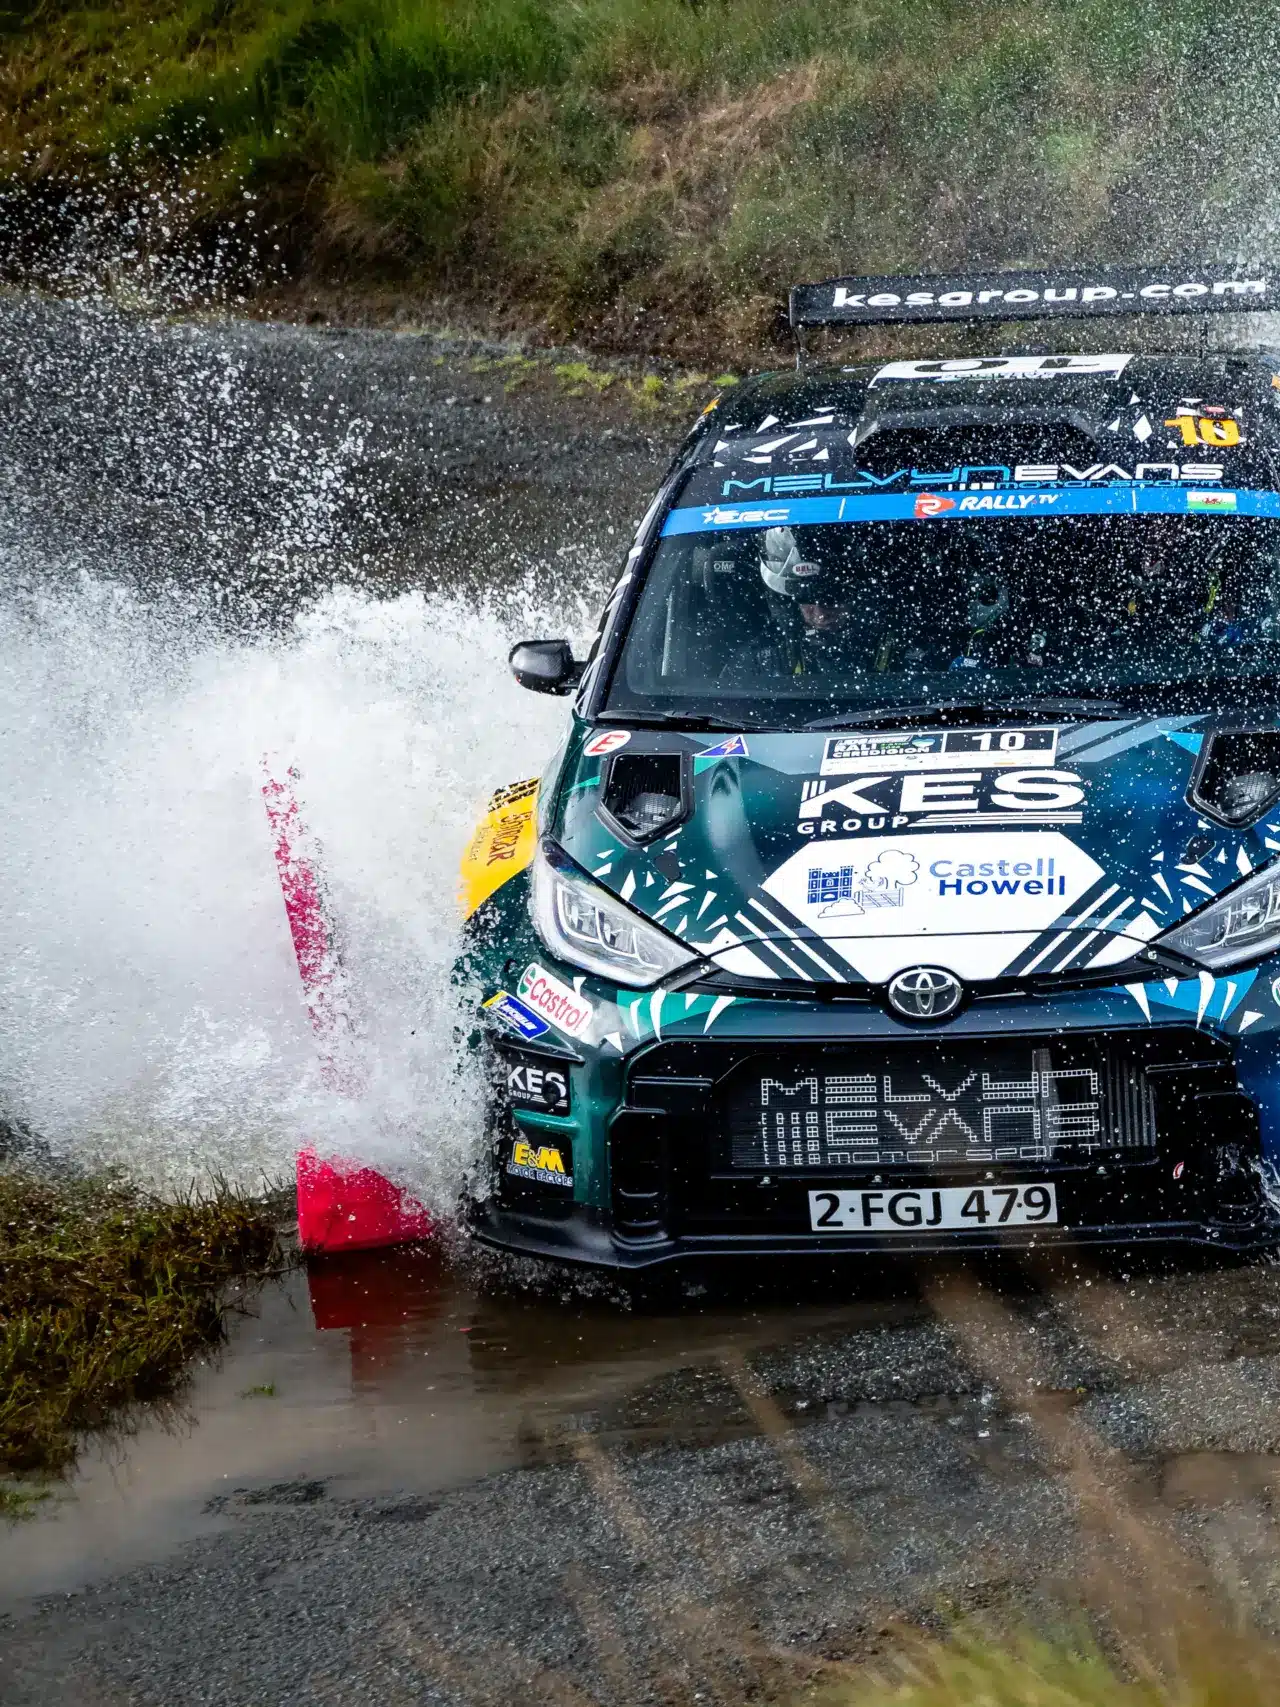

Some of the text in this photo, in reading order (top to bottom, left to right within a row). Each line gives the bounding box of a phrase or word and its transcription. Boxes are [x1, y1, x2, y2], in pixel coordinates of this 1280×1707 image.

[832, 280, 1267, 308] kesgroup.com
[1164, 415, 1241, 447] 10
[832, 747, 930, 758] CEREDIGION
[972, 732, 1026, 751] 10
[799, 769, 1085, 819] KES
[796, 816, 910, 835] GROUP
[929, 857, 1055, 878] Castell
[938, 875, 1066, 897] Howell
[529, 977, 590, 1031] Castrol
[508, 1089, 532, 1100] GROUP
[825, 1102, 1100, 1146] EVANS
[512, 1141, 566, 1174] E&M
[506, 1163, 574, 1187] MOTOR FACTORS
